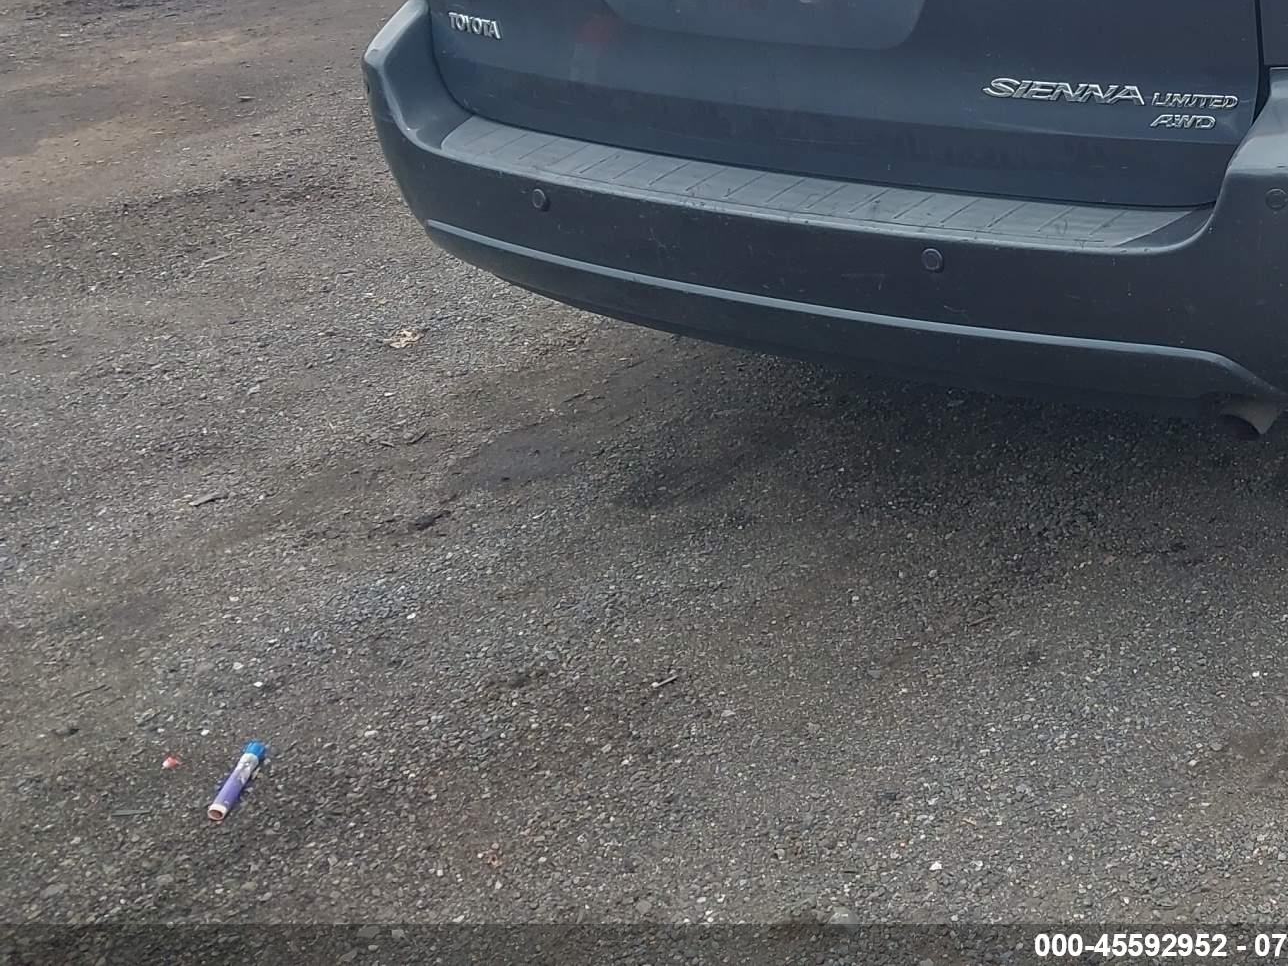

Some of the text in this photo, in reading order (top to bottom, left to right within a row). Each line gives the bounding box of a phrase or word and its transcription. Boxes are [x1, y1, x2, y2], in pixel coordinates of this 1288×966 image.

[447, 11, 501, 39] TOYOTA
[982, 77, 1239, 109] SIENNA LIMITED
[1149, 113, 1217, 129] AWD
